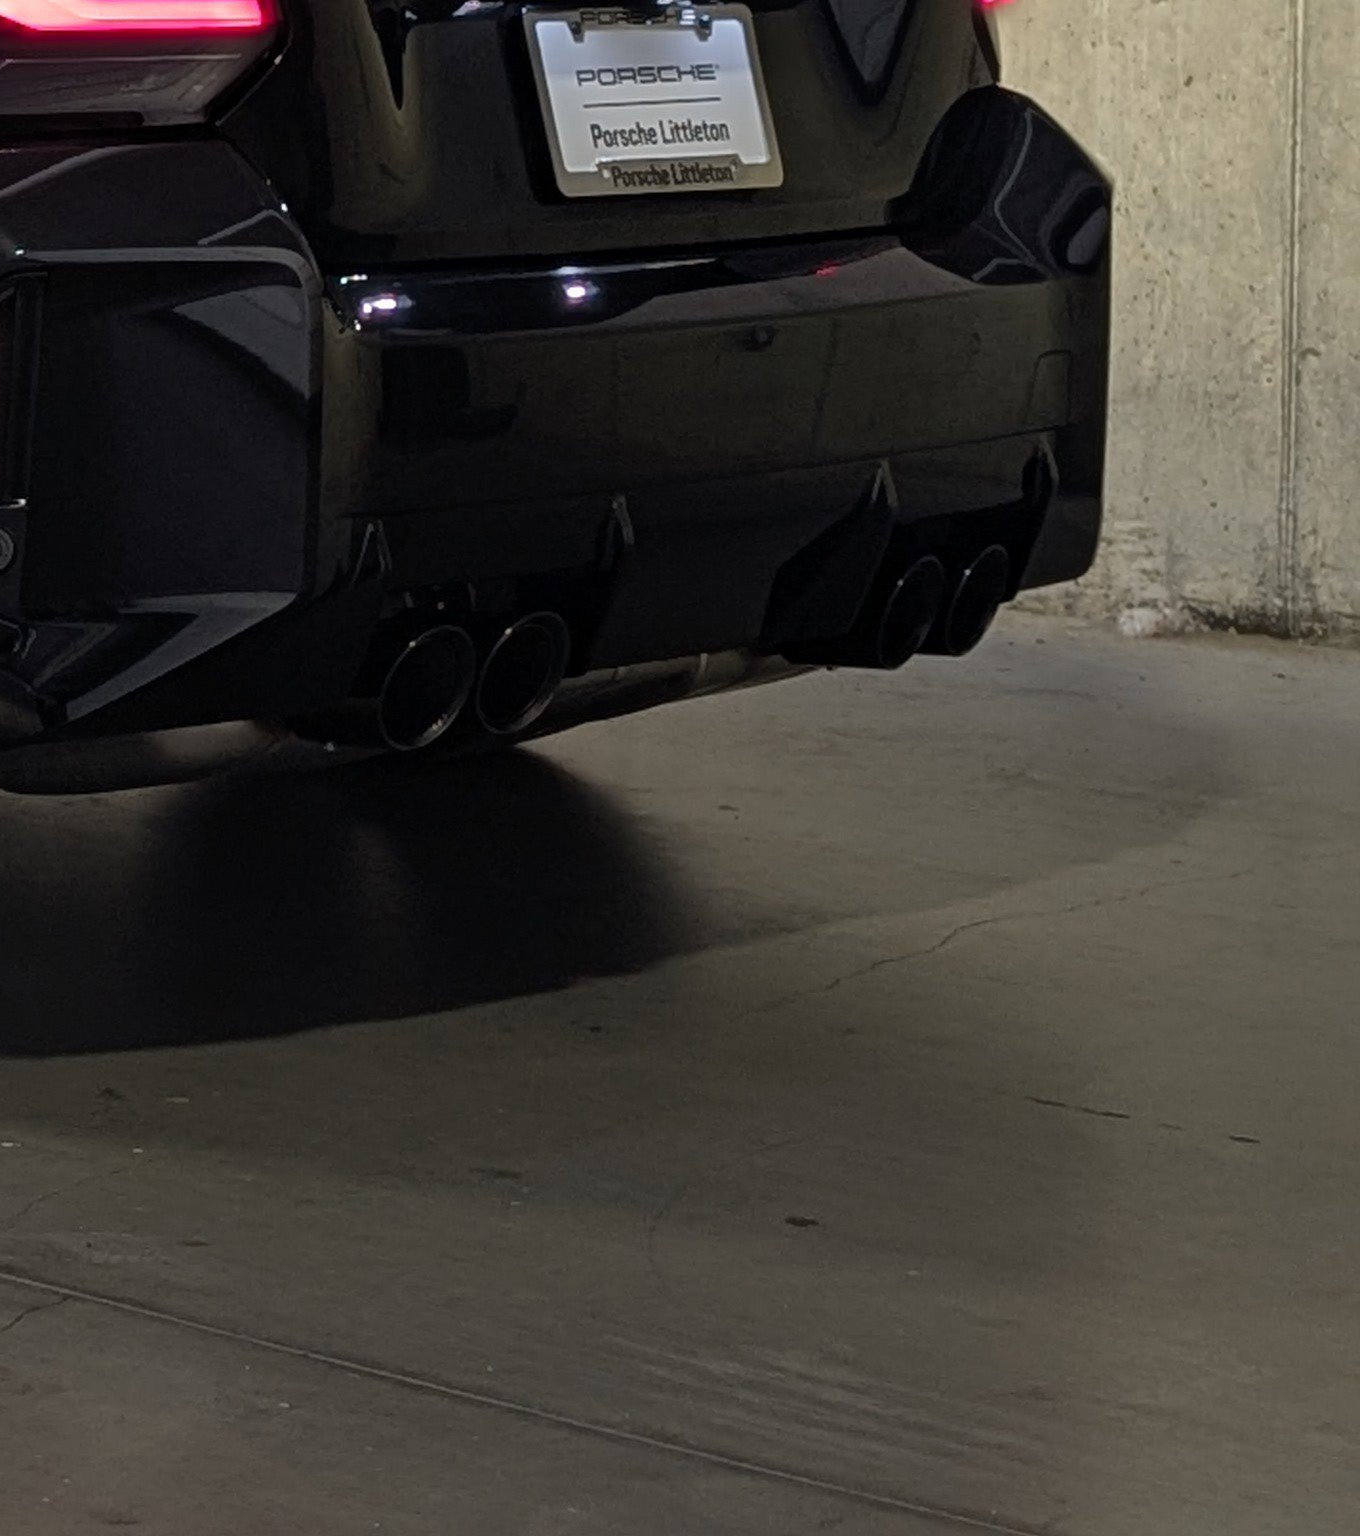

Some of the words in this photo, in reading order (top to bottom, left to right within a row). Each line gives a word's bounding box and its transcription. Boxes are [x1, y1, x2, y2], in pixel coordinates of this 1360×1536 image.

[575, 64, 717, 86] PORSCHE
[590, 121, 658, 149] Porsche
[658, 118, 731, 145] Littleton
[611, 164, 670, 188] Porsche
[670, 162, 734, 186] Littleton
